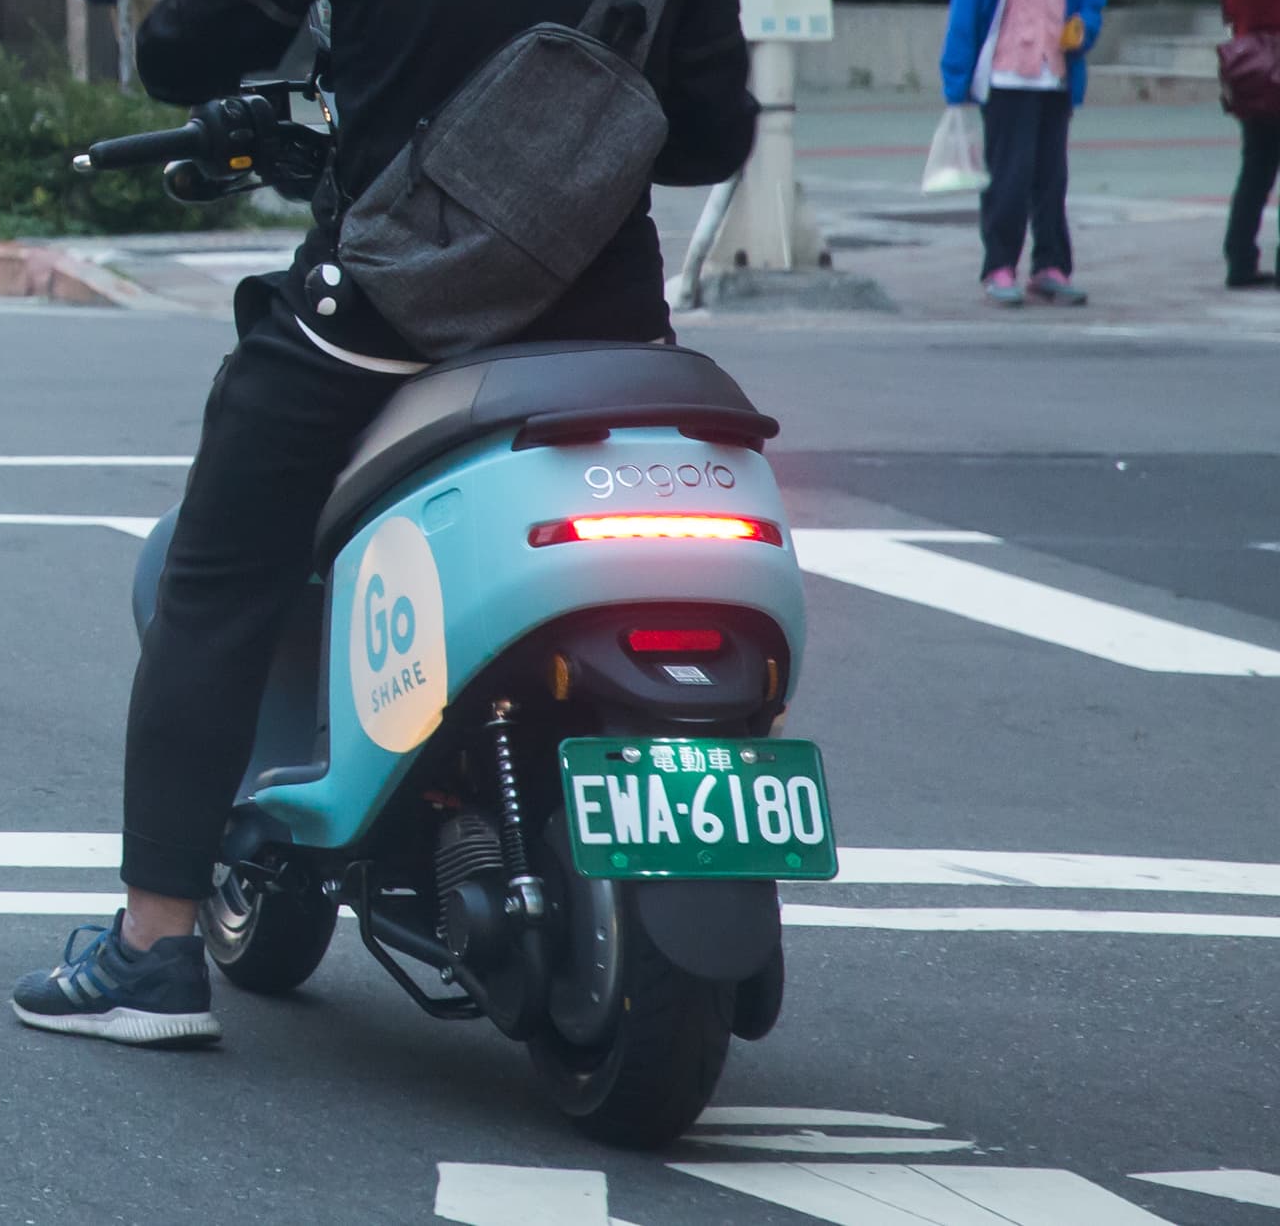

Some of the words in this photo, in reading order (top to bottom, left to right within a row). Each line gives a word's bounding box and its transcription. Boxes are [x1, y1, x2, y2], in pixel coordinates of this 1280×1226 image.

[584, 460, 736, 500] gogoro
[364, 574, 416, 672] Go
[371, 661, 427, 713] SHARE
[649, 745, 734, 773] 電動車
